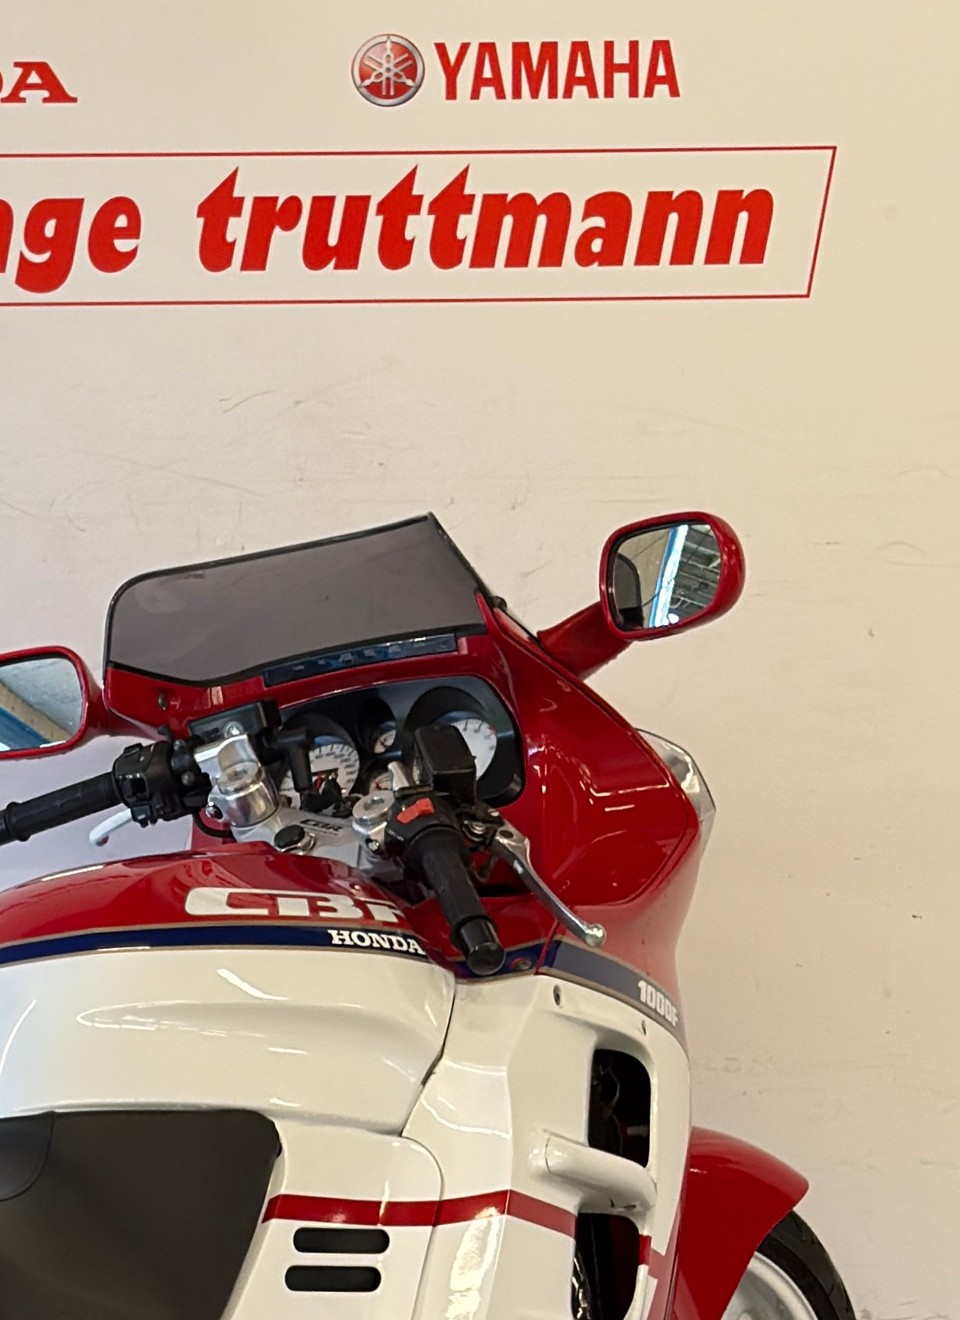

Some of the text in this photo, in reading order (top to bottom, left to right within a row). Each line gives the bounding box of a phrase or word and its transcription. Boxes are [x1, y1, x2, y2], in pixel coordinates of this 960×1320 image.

[433, 38, 681, 102] YAMAHA
[196, 164, 775, 273] truttmann
[328, 929, 425, 955] HONDA
